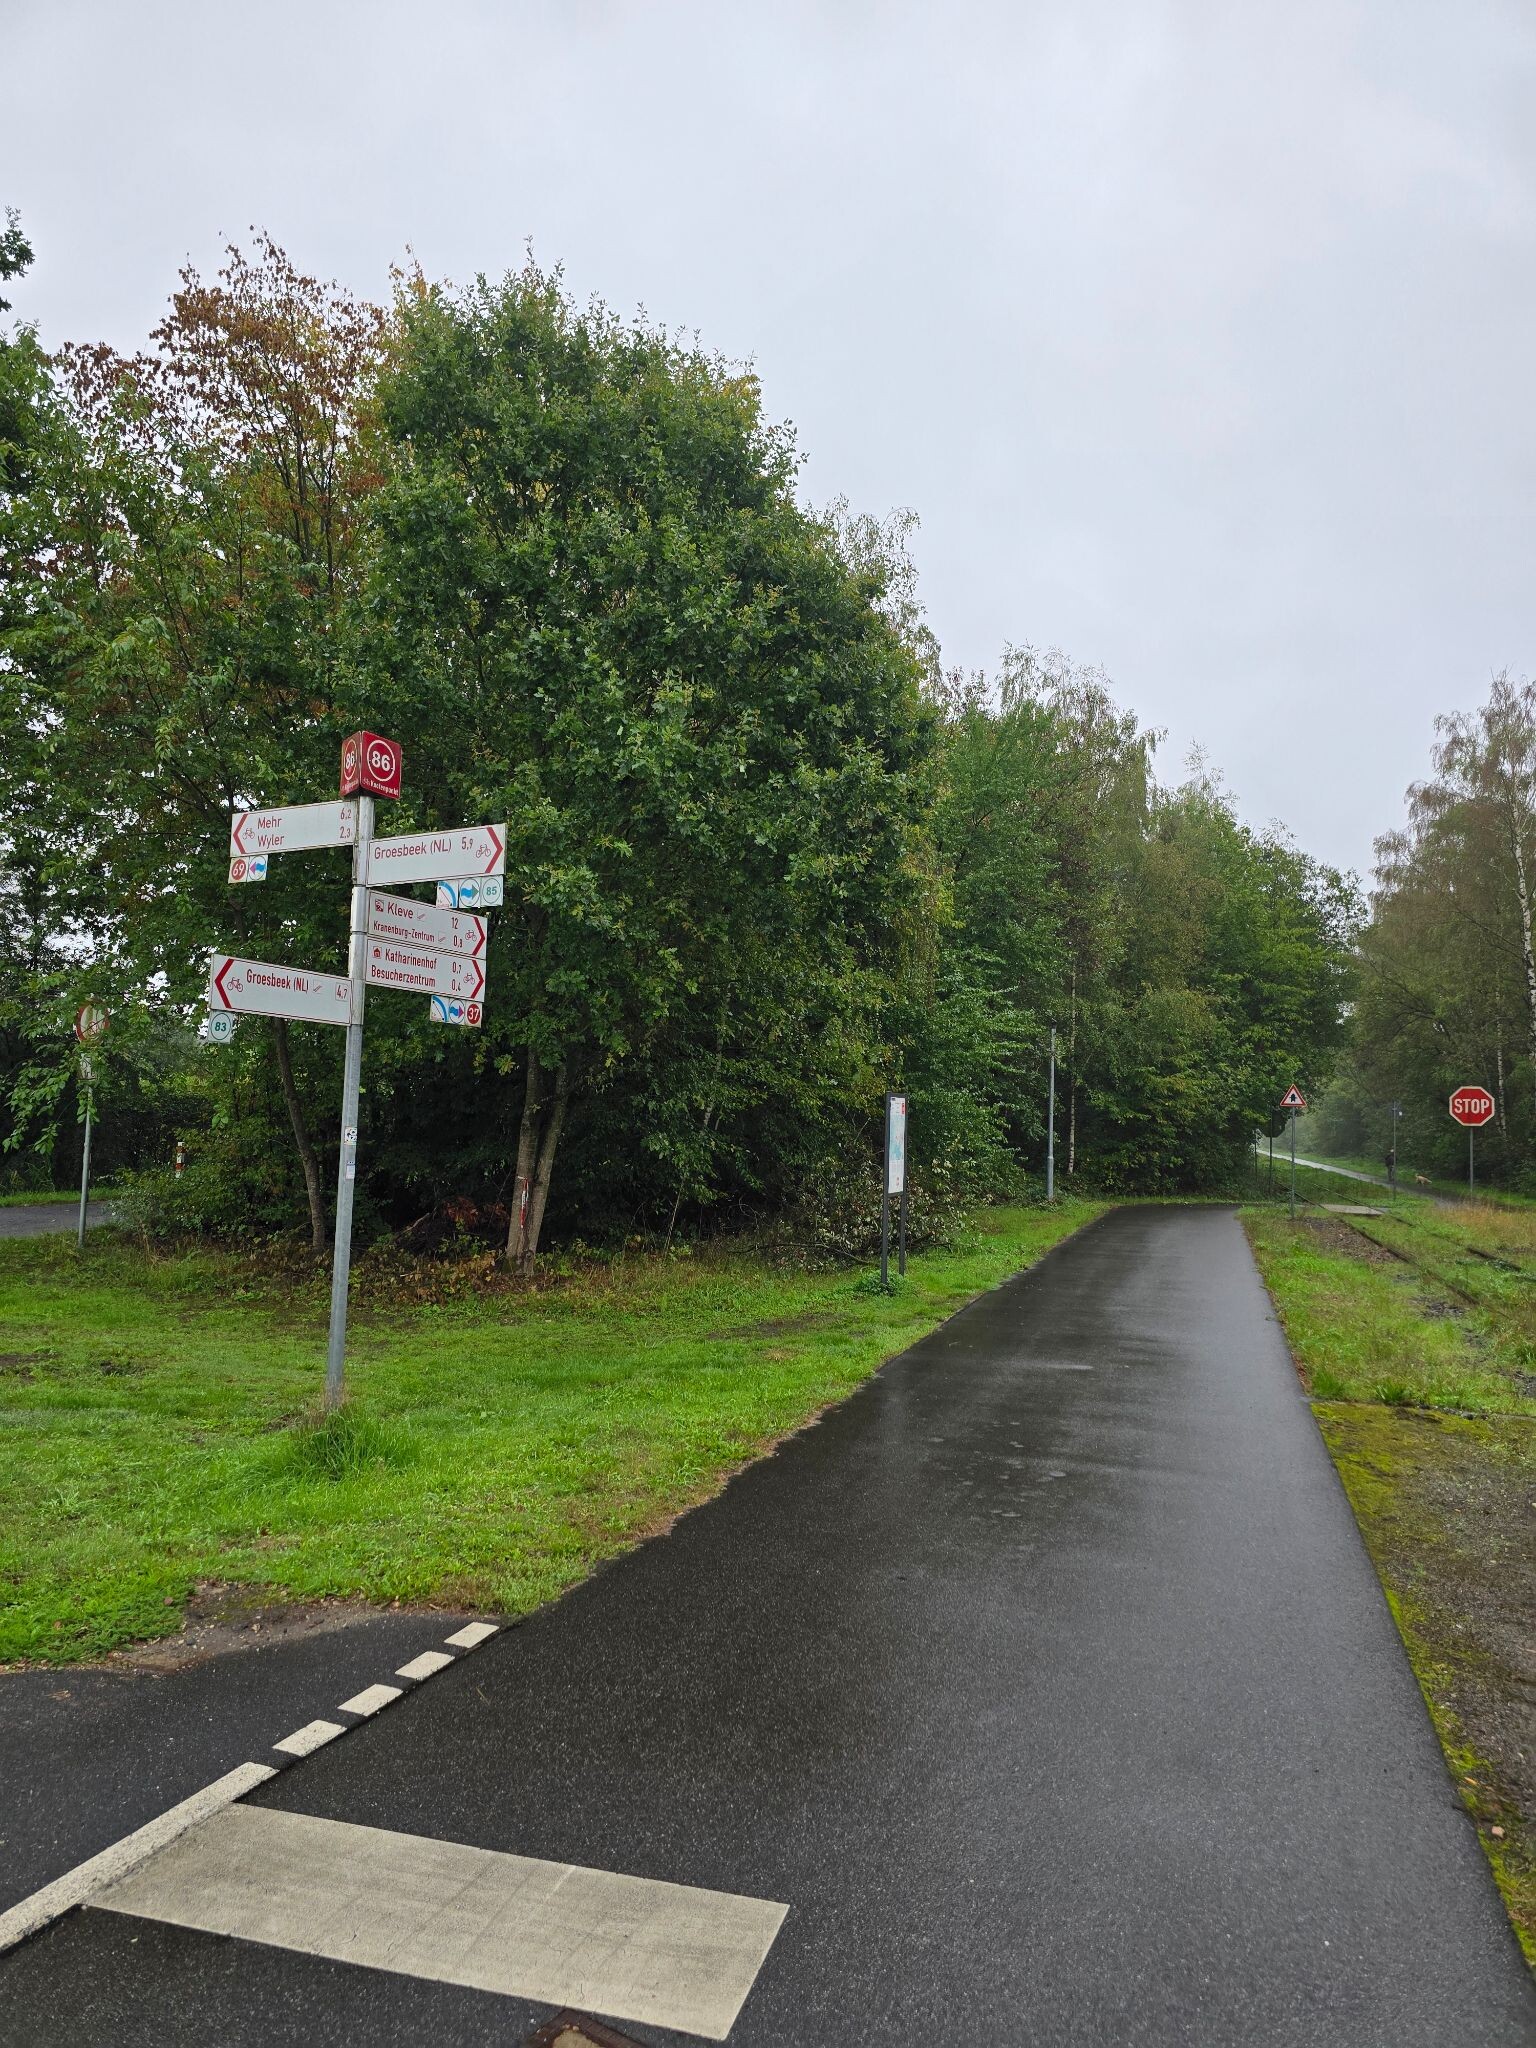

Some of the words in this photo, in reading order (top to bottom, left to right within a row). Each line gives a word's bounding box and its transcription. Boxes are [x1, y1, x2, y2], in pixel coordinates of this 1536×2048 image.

[346, 751, 354, 770] 86
[372, 750, 390, 772] 86
[258, 816, 282, 830] Mehr
[258, 835, 284, 849] Wyler
[374, 842, 426, 859] Groesbeek
[430, 838, 452, 855] (NL)
[461, 836, 474, 850] 5,9
[232, 863, 244, 877] 69
[486, 886, 497, 896] 85
[388, 902, 414, 918] Kleve
[451, 917, 459, 930] 12
[374, 920, 434, 942] Kranenburg-Zentrum
[386, 948, 437, 969] Katharinenhof
[246, 968, 290, 989] Groesbeek
[294, 977, 309, 994] (NL)
[372, 964, 436, 988] Besucherzentrum
[468, 1007, 480, 1020] 37
[214, 1022, 226, 1032] 83
[1454, 1098, 1490, 1114] STOP
